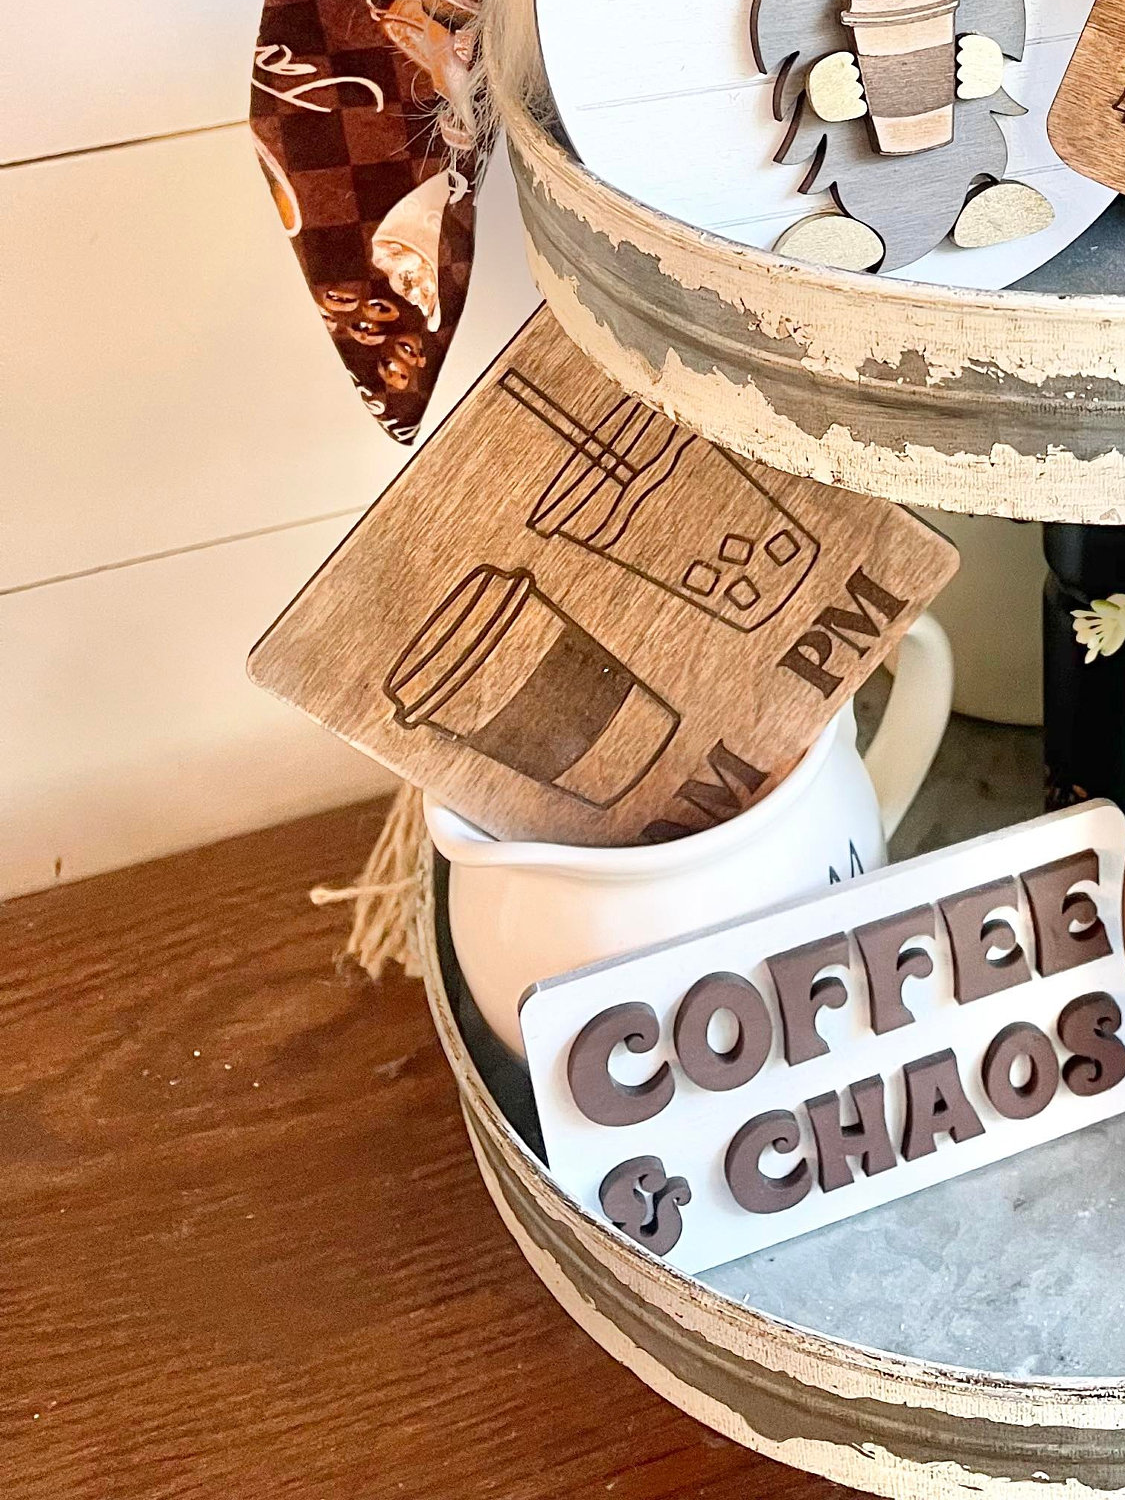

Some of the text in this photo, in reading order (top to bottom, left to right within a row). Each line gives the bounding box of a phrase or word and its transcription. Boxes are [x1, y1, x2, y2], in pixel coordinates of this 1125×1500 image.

[777, 569, 910, 699] PM
[636, 738, 771, 845] M
[567, 848, 1113, 1127] COFFEE
[598, 1155, 692, 1257] &
